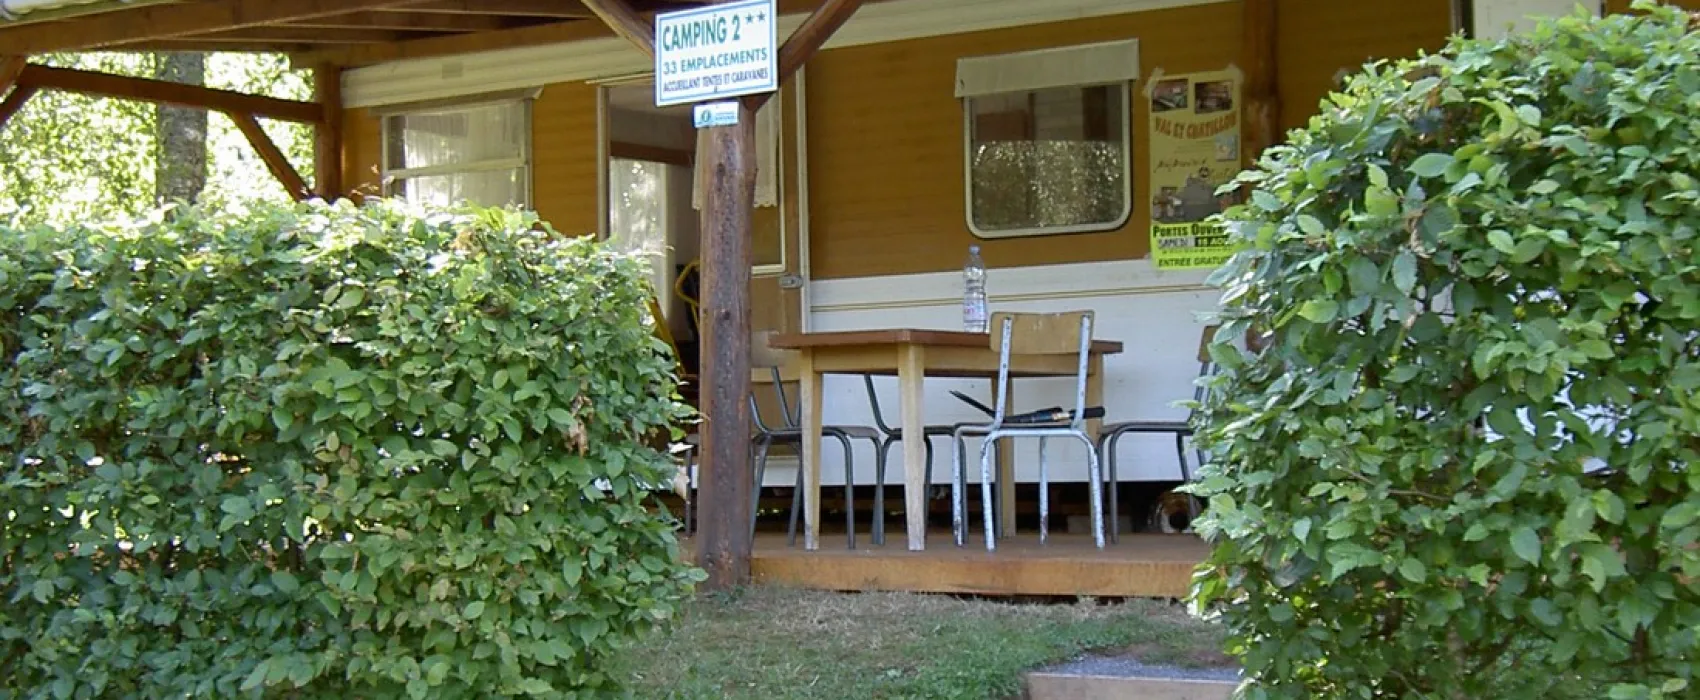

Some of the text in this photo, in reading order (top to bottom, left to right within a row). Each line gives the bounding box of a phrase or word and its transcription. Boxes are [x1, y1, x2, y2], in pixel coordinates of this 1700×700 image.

[662, 14, 740, 51] CAMPING 2
[663, 47, 767, 75] 33 EMPLACEMENTS
[664, 67, 768, 92] ACCUEILLANT TENTES ET CARAVANES
[1153, 225, 1188, 238] PORTES
